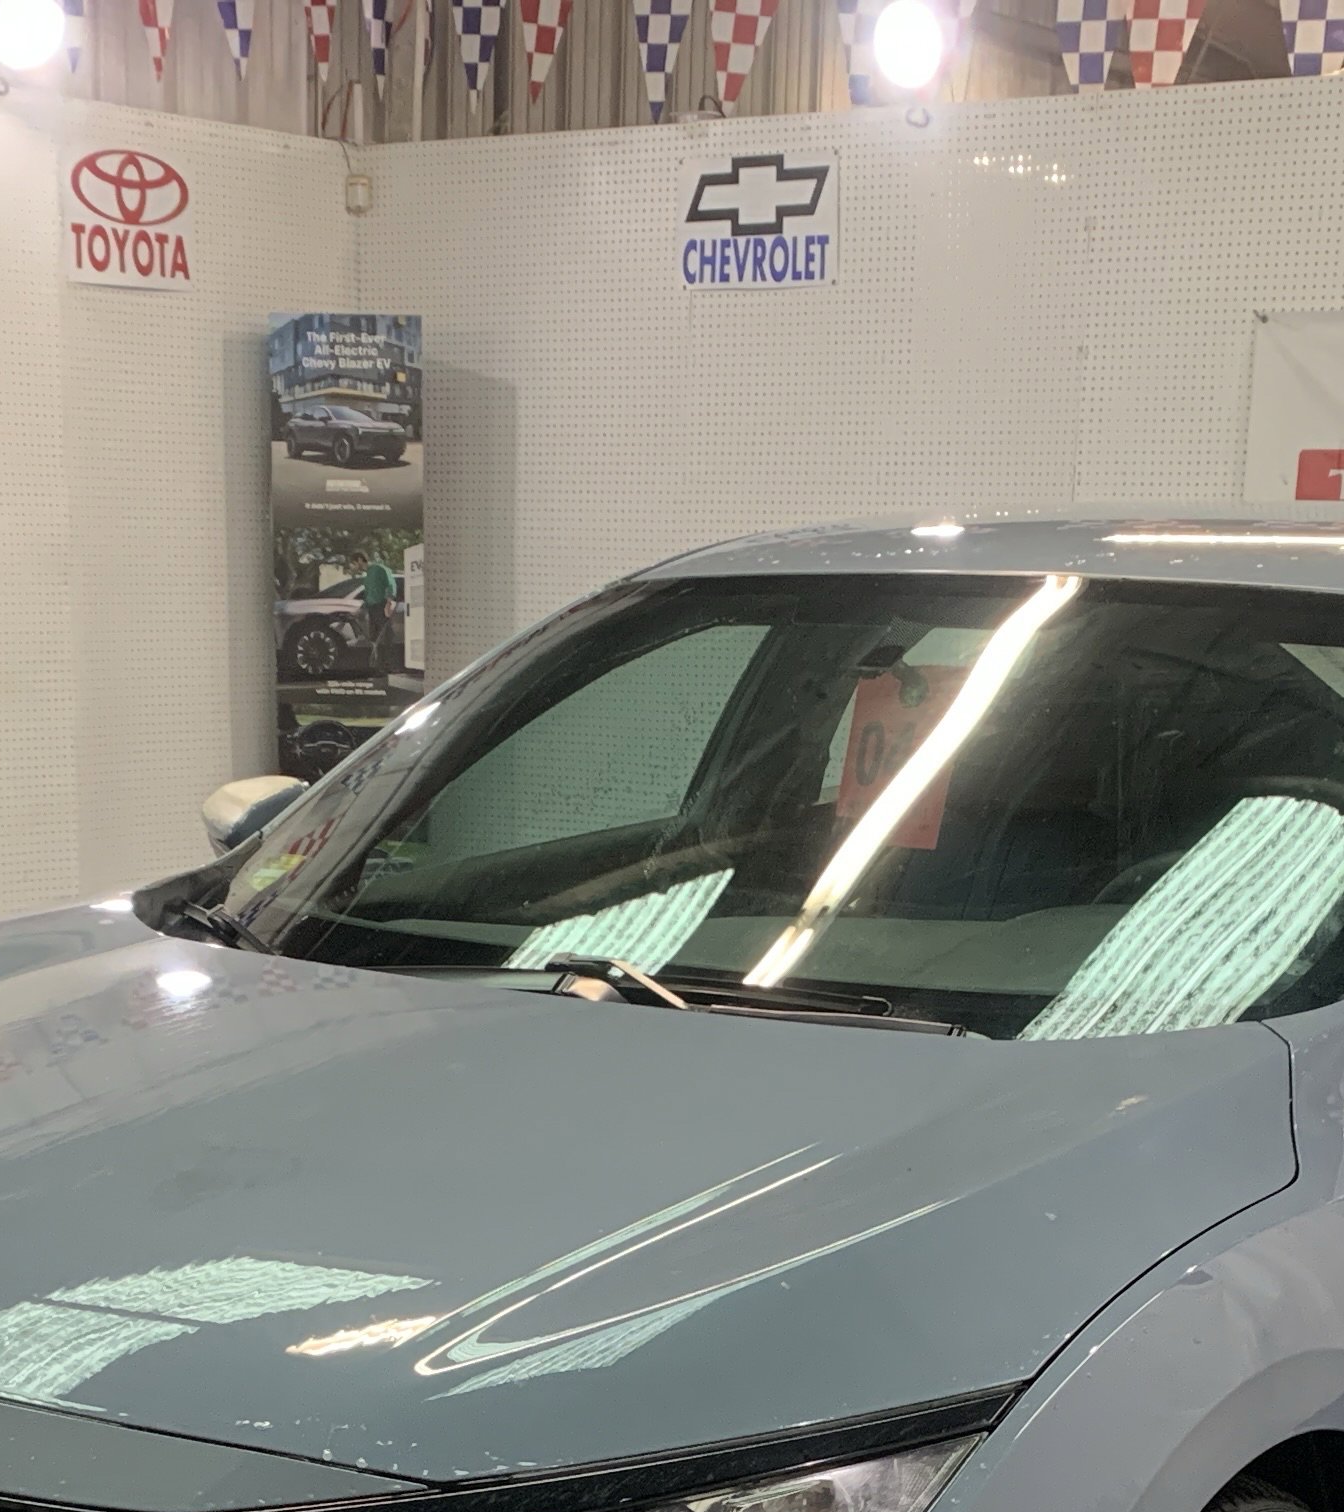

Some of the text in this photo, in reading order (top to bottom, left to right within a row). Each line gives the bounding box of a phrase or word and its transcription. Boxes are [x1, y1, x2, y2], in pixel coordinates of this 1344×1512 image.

[71, 222, 190, 280] TOYOTA
[682, 234, 829, 284] CHEVROLET
[307, 332, 386, 343] The First-Ever
[314, 345, 378, 356] All-Electric
[302, 357, 391, 370] Chevy Blazer EV
